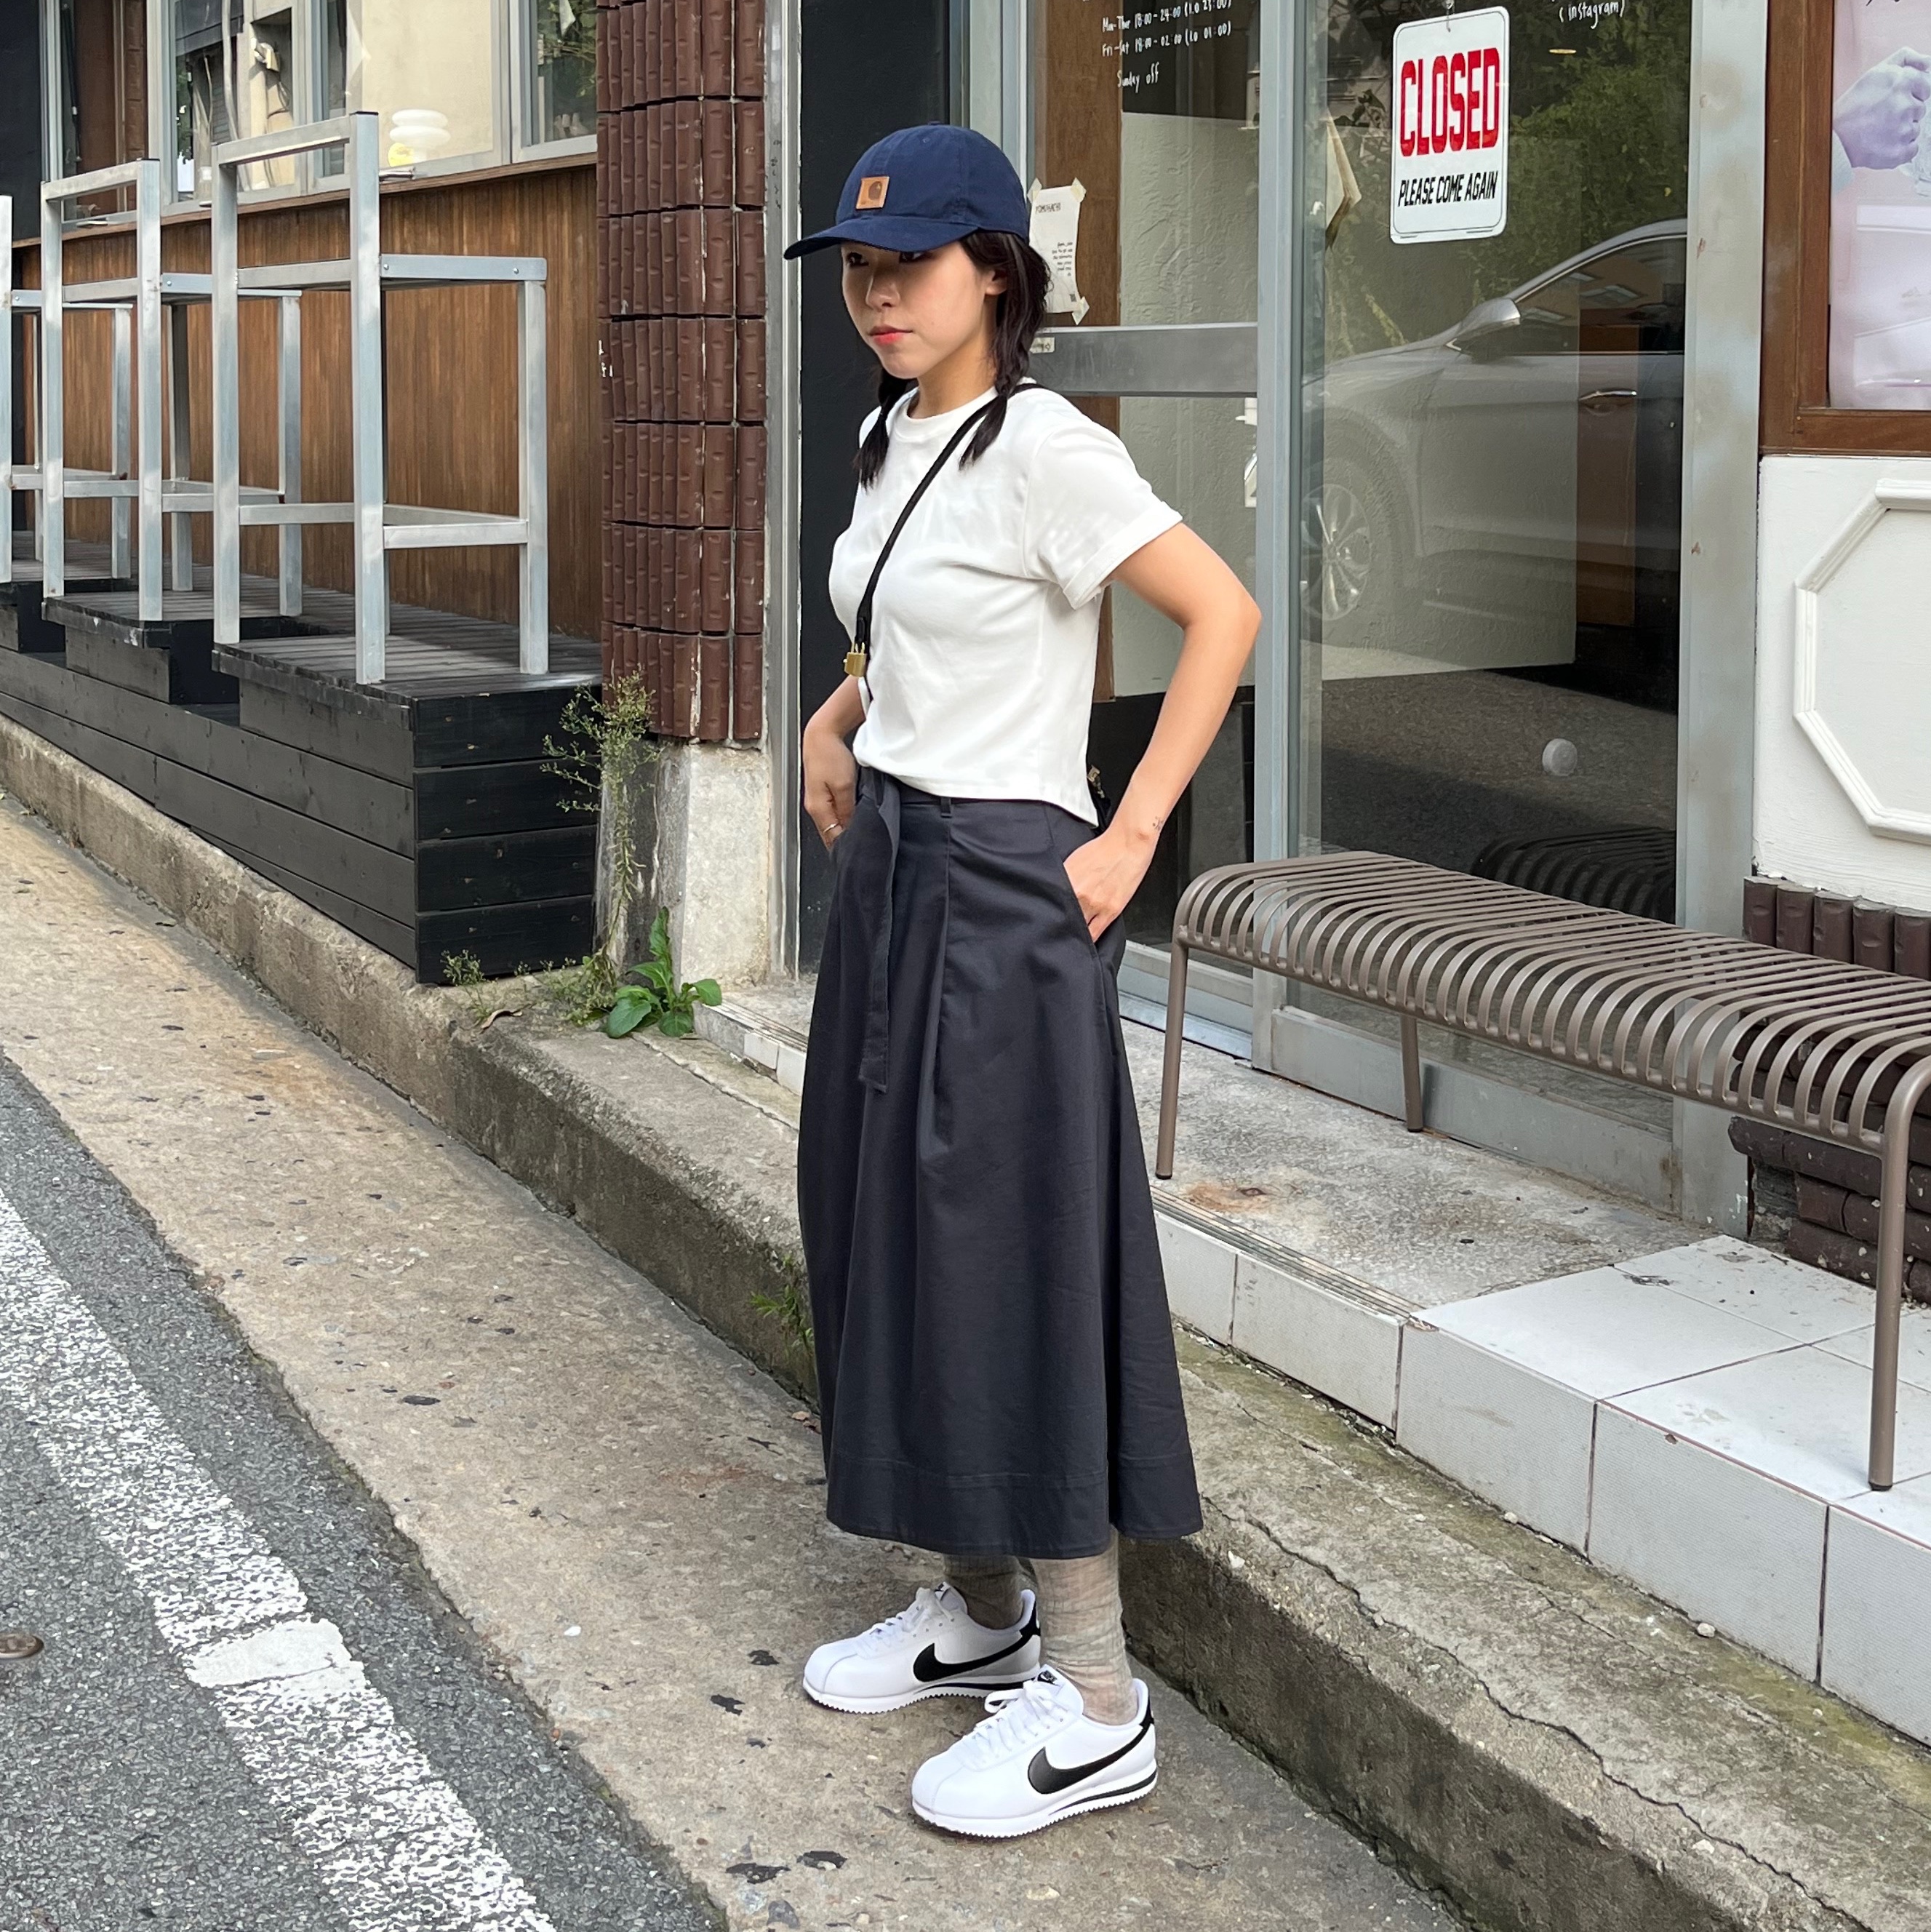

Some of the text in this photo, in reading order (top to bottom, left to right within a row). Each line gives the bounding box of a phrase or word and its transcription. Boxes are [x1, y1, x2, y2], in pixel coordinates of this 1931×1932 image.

[1116, 61, 1160, 93] Sunday off
[1399, 47, 1500, 157] CLOSED
[1397, 170, 1498, 207] PLEASE COME AGAIN
